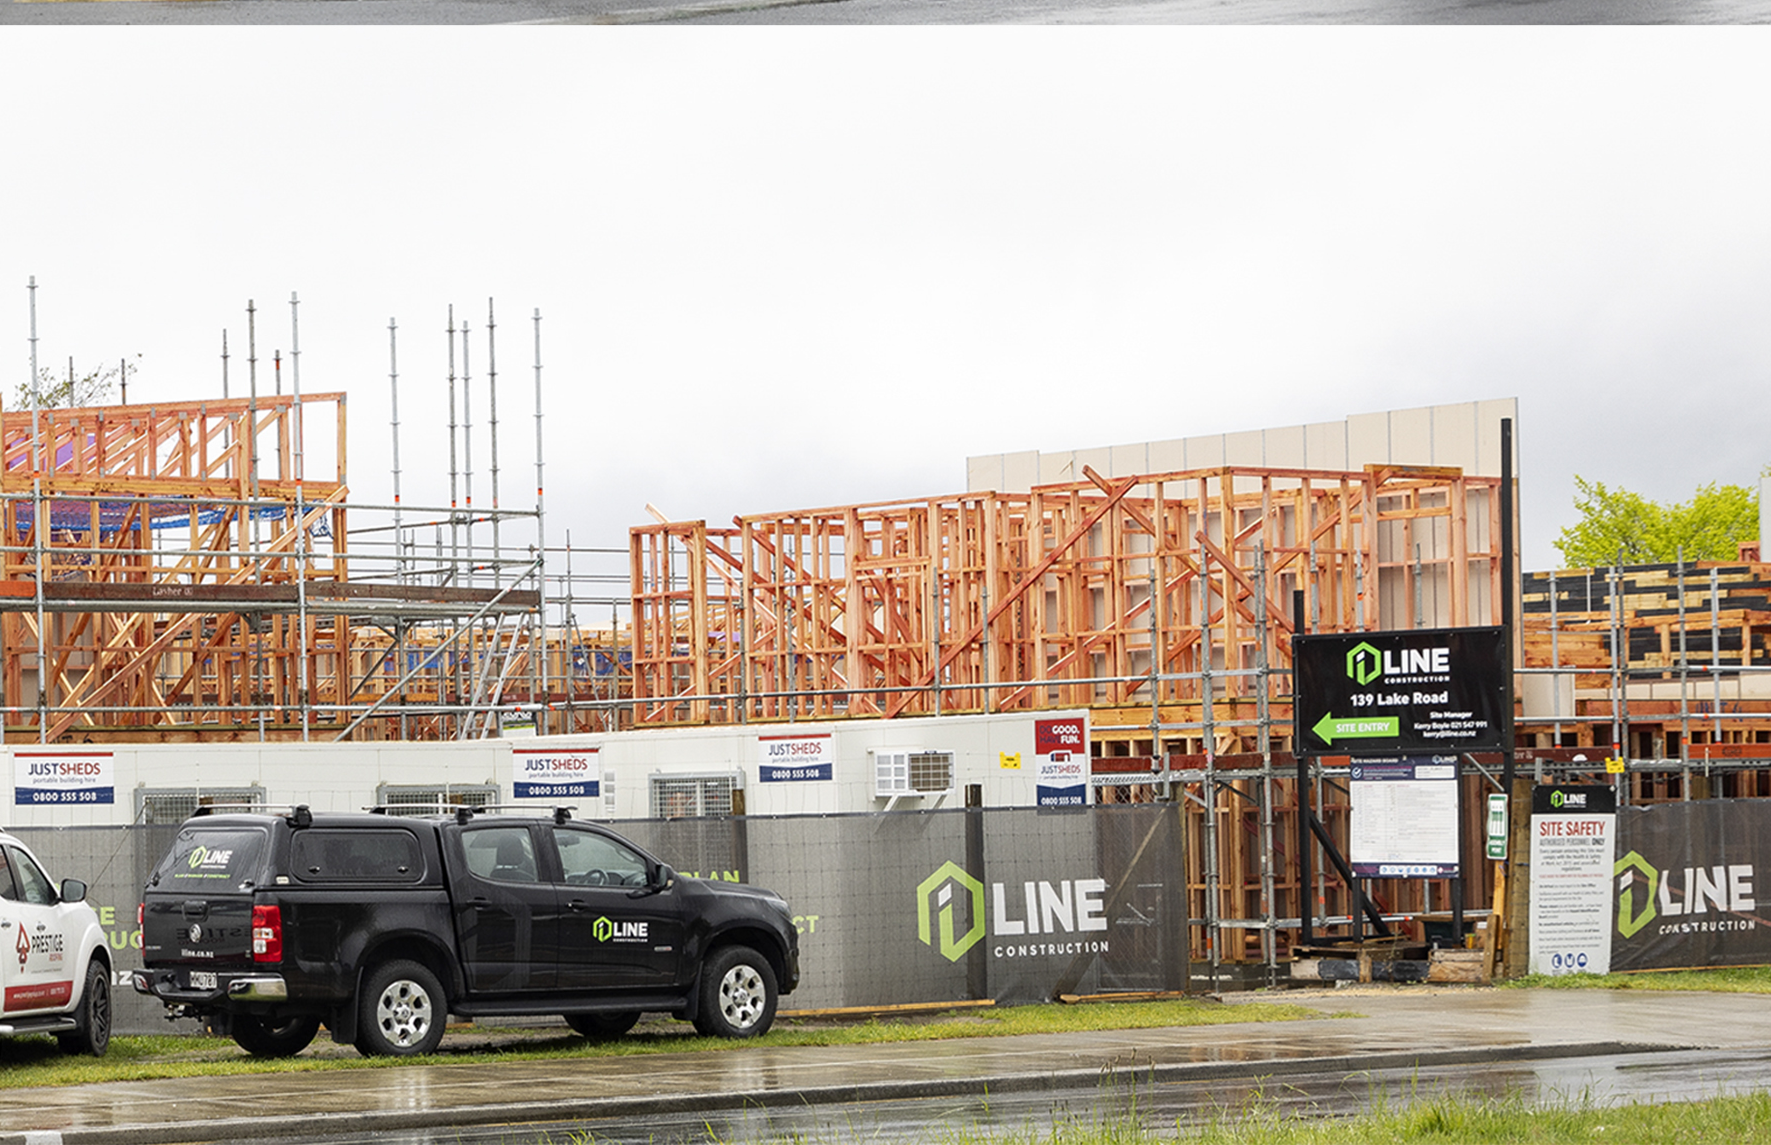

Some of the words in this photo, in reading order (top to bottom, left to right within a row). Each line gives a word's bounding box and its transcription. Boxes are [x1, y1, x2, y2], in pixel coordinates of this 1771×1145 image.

[1384, 676, 1450, 685] CONSTRUCTION
[1350, 694, 1374, 707] 139
[1377, 693, 1410, 706] Lake
[1413, 690, 1448, 704] Road
[1444, 711, 1473, 720] Manager
[1052, 725, 1080, 734] GOOD.
[1336, 723, 1356, 733] SITE
[1358, 722, 1390, 732] ENTRY
[1061, 735, 1080, 744] FUN.
[769, 742, 822, 755] JUSTSHEDS
[28, 762, 101, 776] JUSTSHEDS
[525, 758, 588, 772] JUSTSHEDS
[529, 772, 551, 780] portable
[552, 771, 572, 779] building
[772, 769, 791, 778] 0800
[793, 769, 805, 778] 555
[806, 768, 820, 778] 508
[32, 776, 58, 785] portable
[60, 775, 84, 785] building
[86, 775, 96, 783] hire
[528, 785, 551, 795] 0800
[553, 785, 568, 795] 555
[570, 785, 585, 795] 508
[33, 792, 58, 802] 0800
[60, 792, 77, 802] 555
[79, 791, 97, 801] 508
[1041, 797, 1057, 805] 0800
[1539, 821, 1563, 836] SITE
[1566, 821, 1606, 836] SAFETY
[1659, 920, 1755, 935] CONSTRUCTION
[31, 934, 64, 954] PRESTIGE
[994, 941, 1109, 957] CONSTRUCTION
